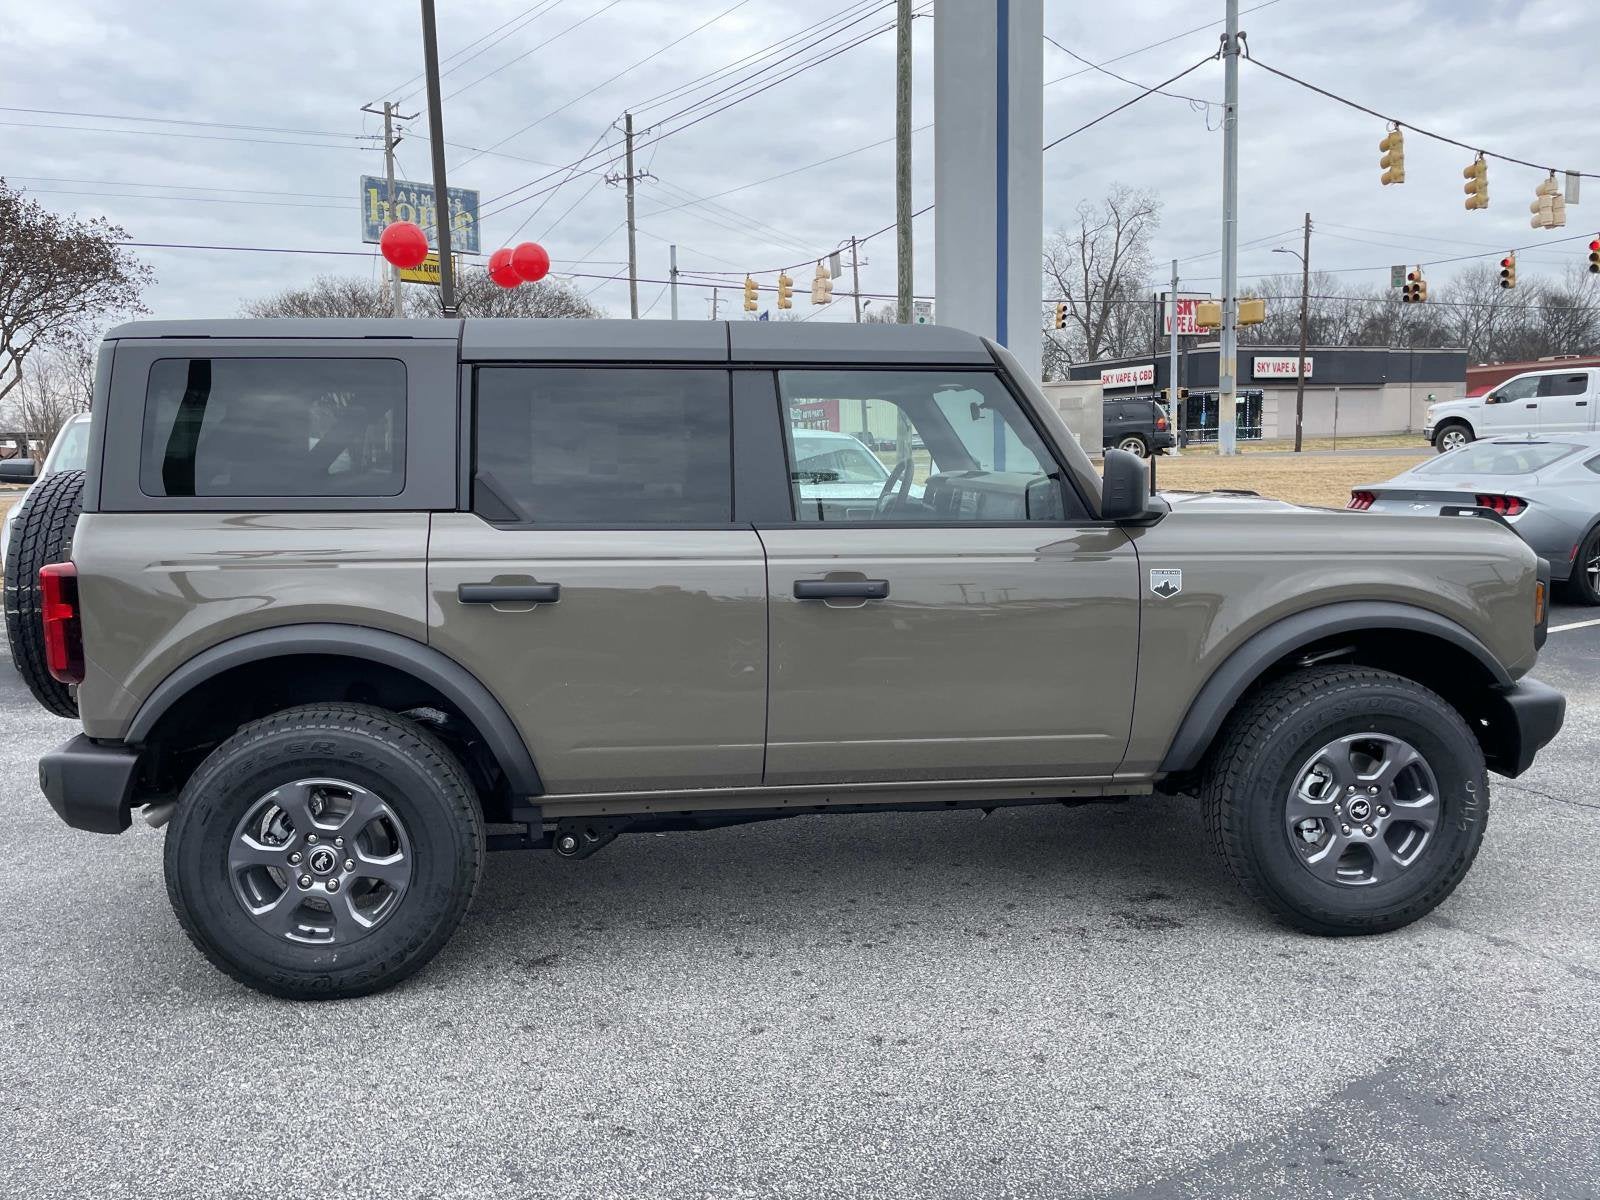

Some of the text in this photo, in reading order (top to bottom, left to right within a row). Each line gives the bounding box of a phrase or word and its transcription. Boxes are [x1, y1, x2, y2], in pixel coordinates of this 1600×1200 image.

[1166, 316, 1186, 332] VPE
[1188, 317, 1193, 332] &
[1257, 362, 1270, 372] SKY
[1273, 362, 1289, 372] VAPE
[1292, 362, 1296, 372] &
[1103, 370, 1152, 384] SKY VAPE & CBD
